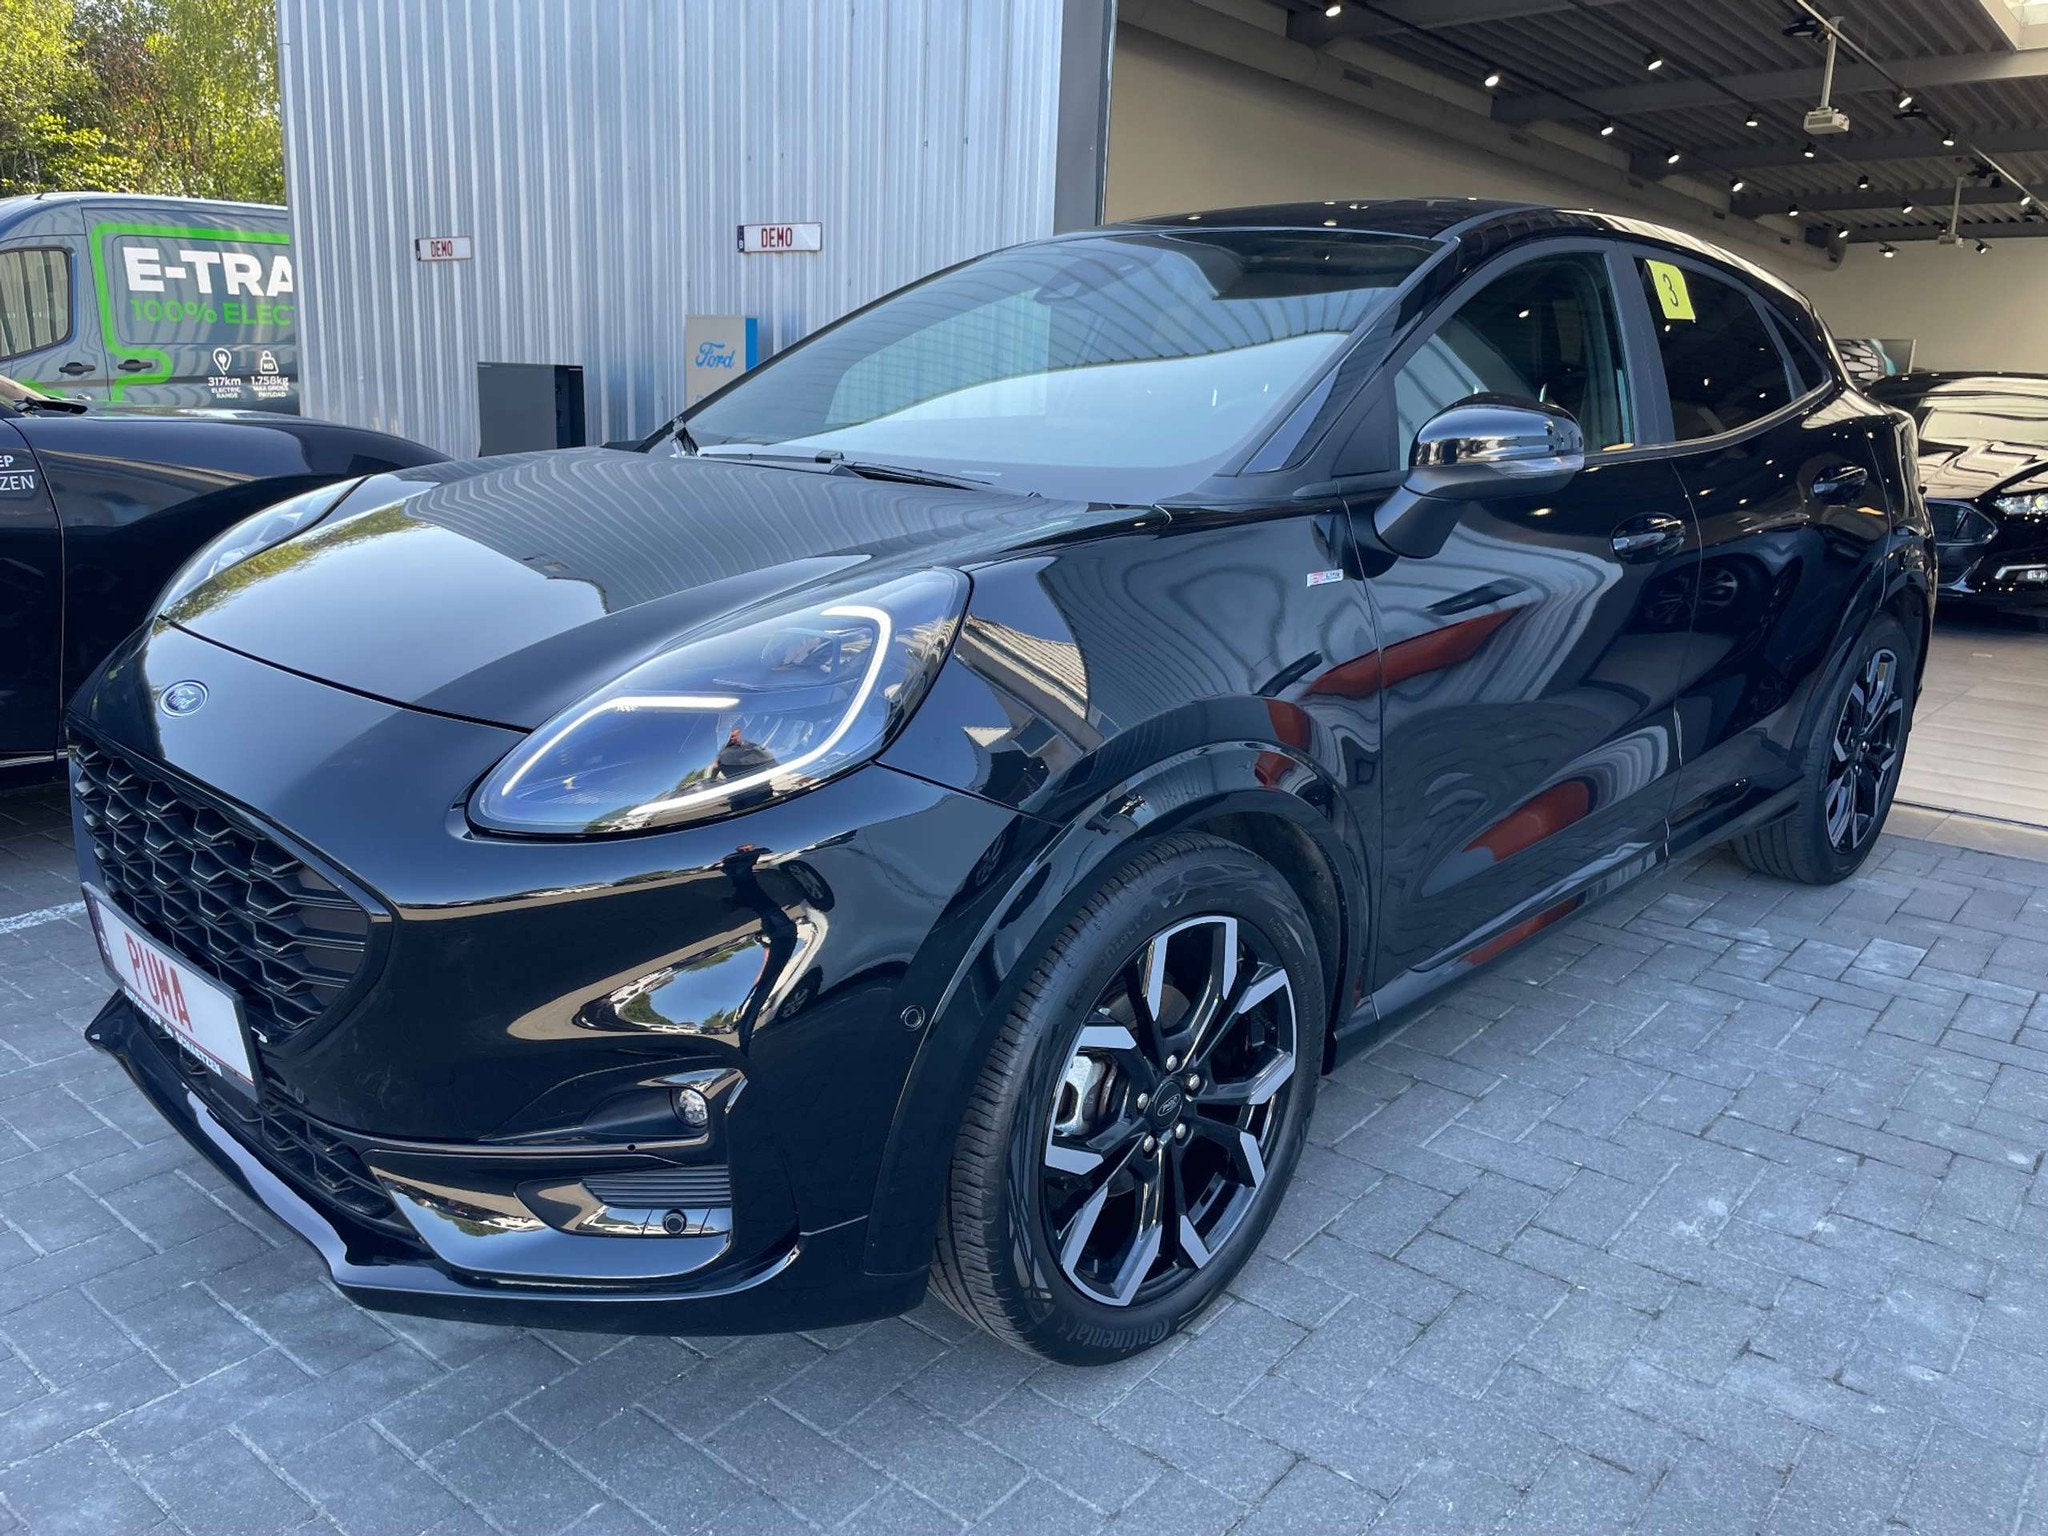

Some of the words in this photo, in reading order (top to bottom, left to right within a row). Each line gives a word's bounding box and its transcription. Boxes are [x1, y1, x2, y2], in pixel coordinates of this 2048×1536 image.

[430, 240, 453, 257] DEMO
[761, 227, 793, 248] DEMO
[1663, 273, 1679, 307] 3
[129, 299, 218, 325] 100%
[223, 302, 295, 326] ELEC
[695, 341, 735, 369] Ford
[208, 376, 241, 387] 317km
[125, 931, 194, 1033] PUMA
[1066, 1318, 1170, 1353] Continental
